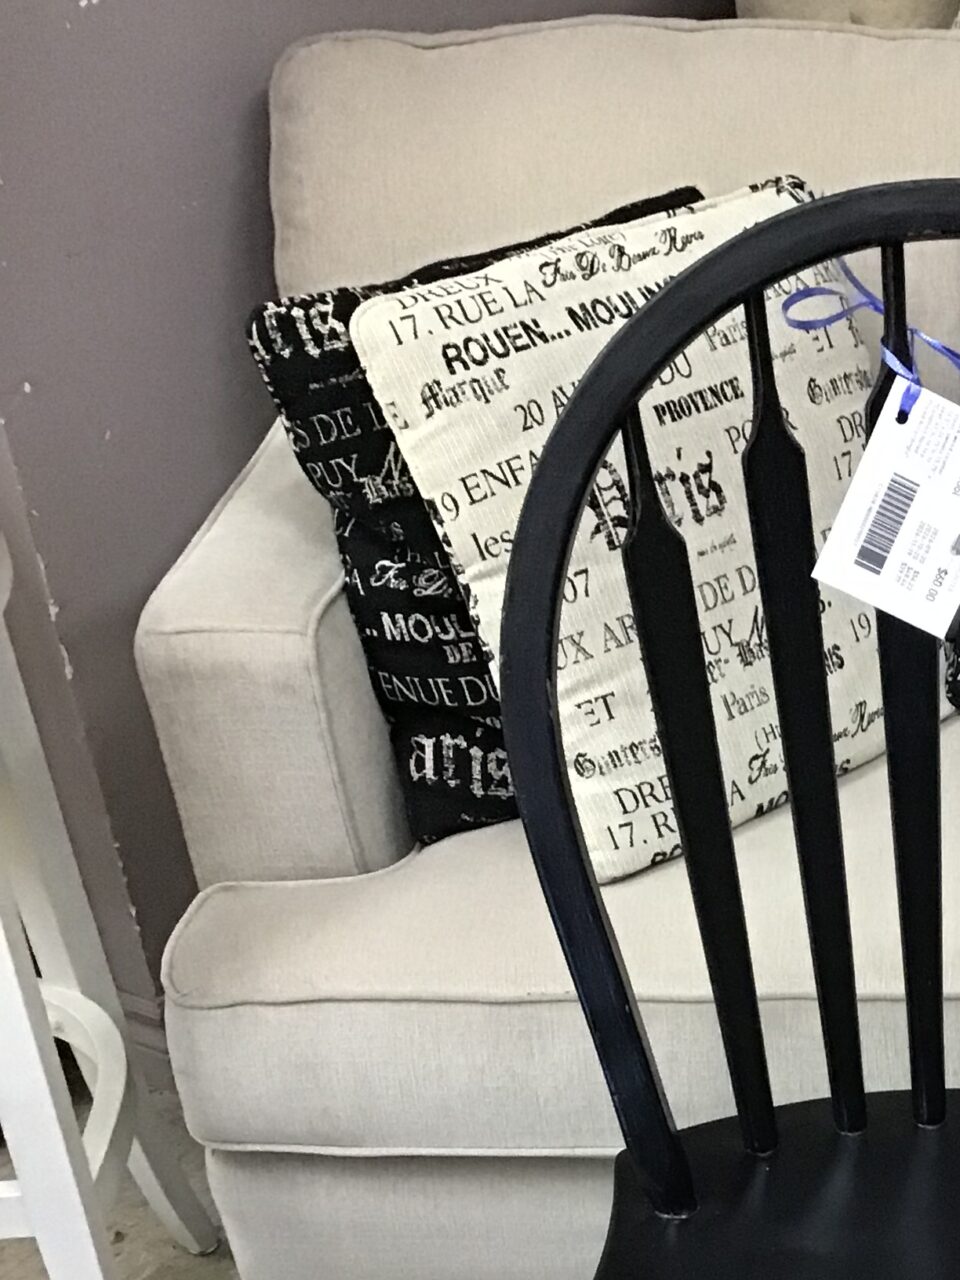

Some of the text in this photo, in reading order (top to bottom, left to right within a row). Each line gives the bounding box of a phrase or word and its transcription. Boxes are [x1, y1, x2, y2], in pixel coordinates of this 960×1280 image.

[389, 279, 547, 346] 17. RUE LA
[442, 318, 572, 376] ROUEN...
[514, 398, 545, 432] 20
[652, 376, 744, 427] PROVENCE
[458, 449, 541, 506] ENFA
[471, 529, 514, 561] les
[697, 571, 735, 613] DE
[923, 565, 949, 603] $60.00
[379, 611, 477, 643] MOUL
[850, 613, 872, 643] 19
[378, 671, 458, 707] ENUE
[720, 685, 771, 721] Paris
[574, 691, 616, 727] ET
[408, 731, 517, 799] aris
[613, 774, 673, 815] DRE
[606, 820, 648, 851] 17.
